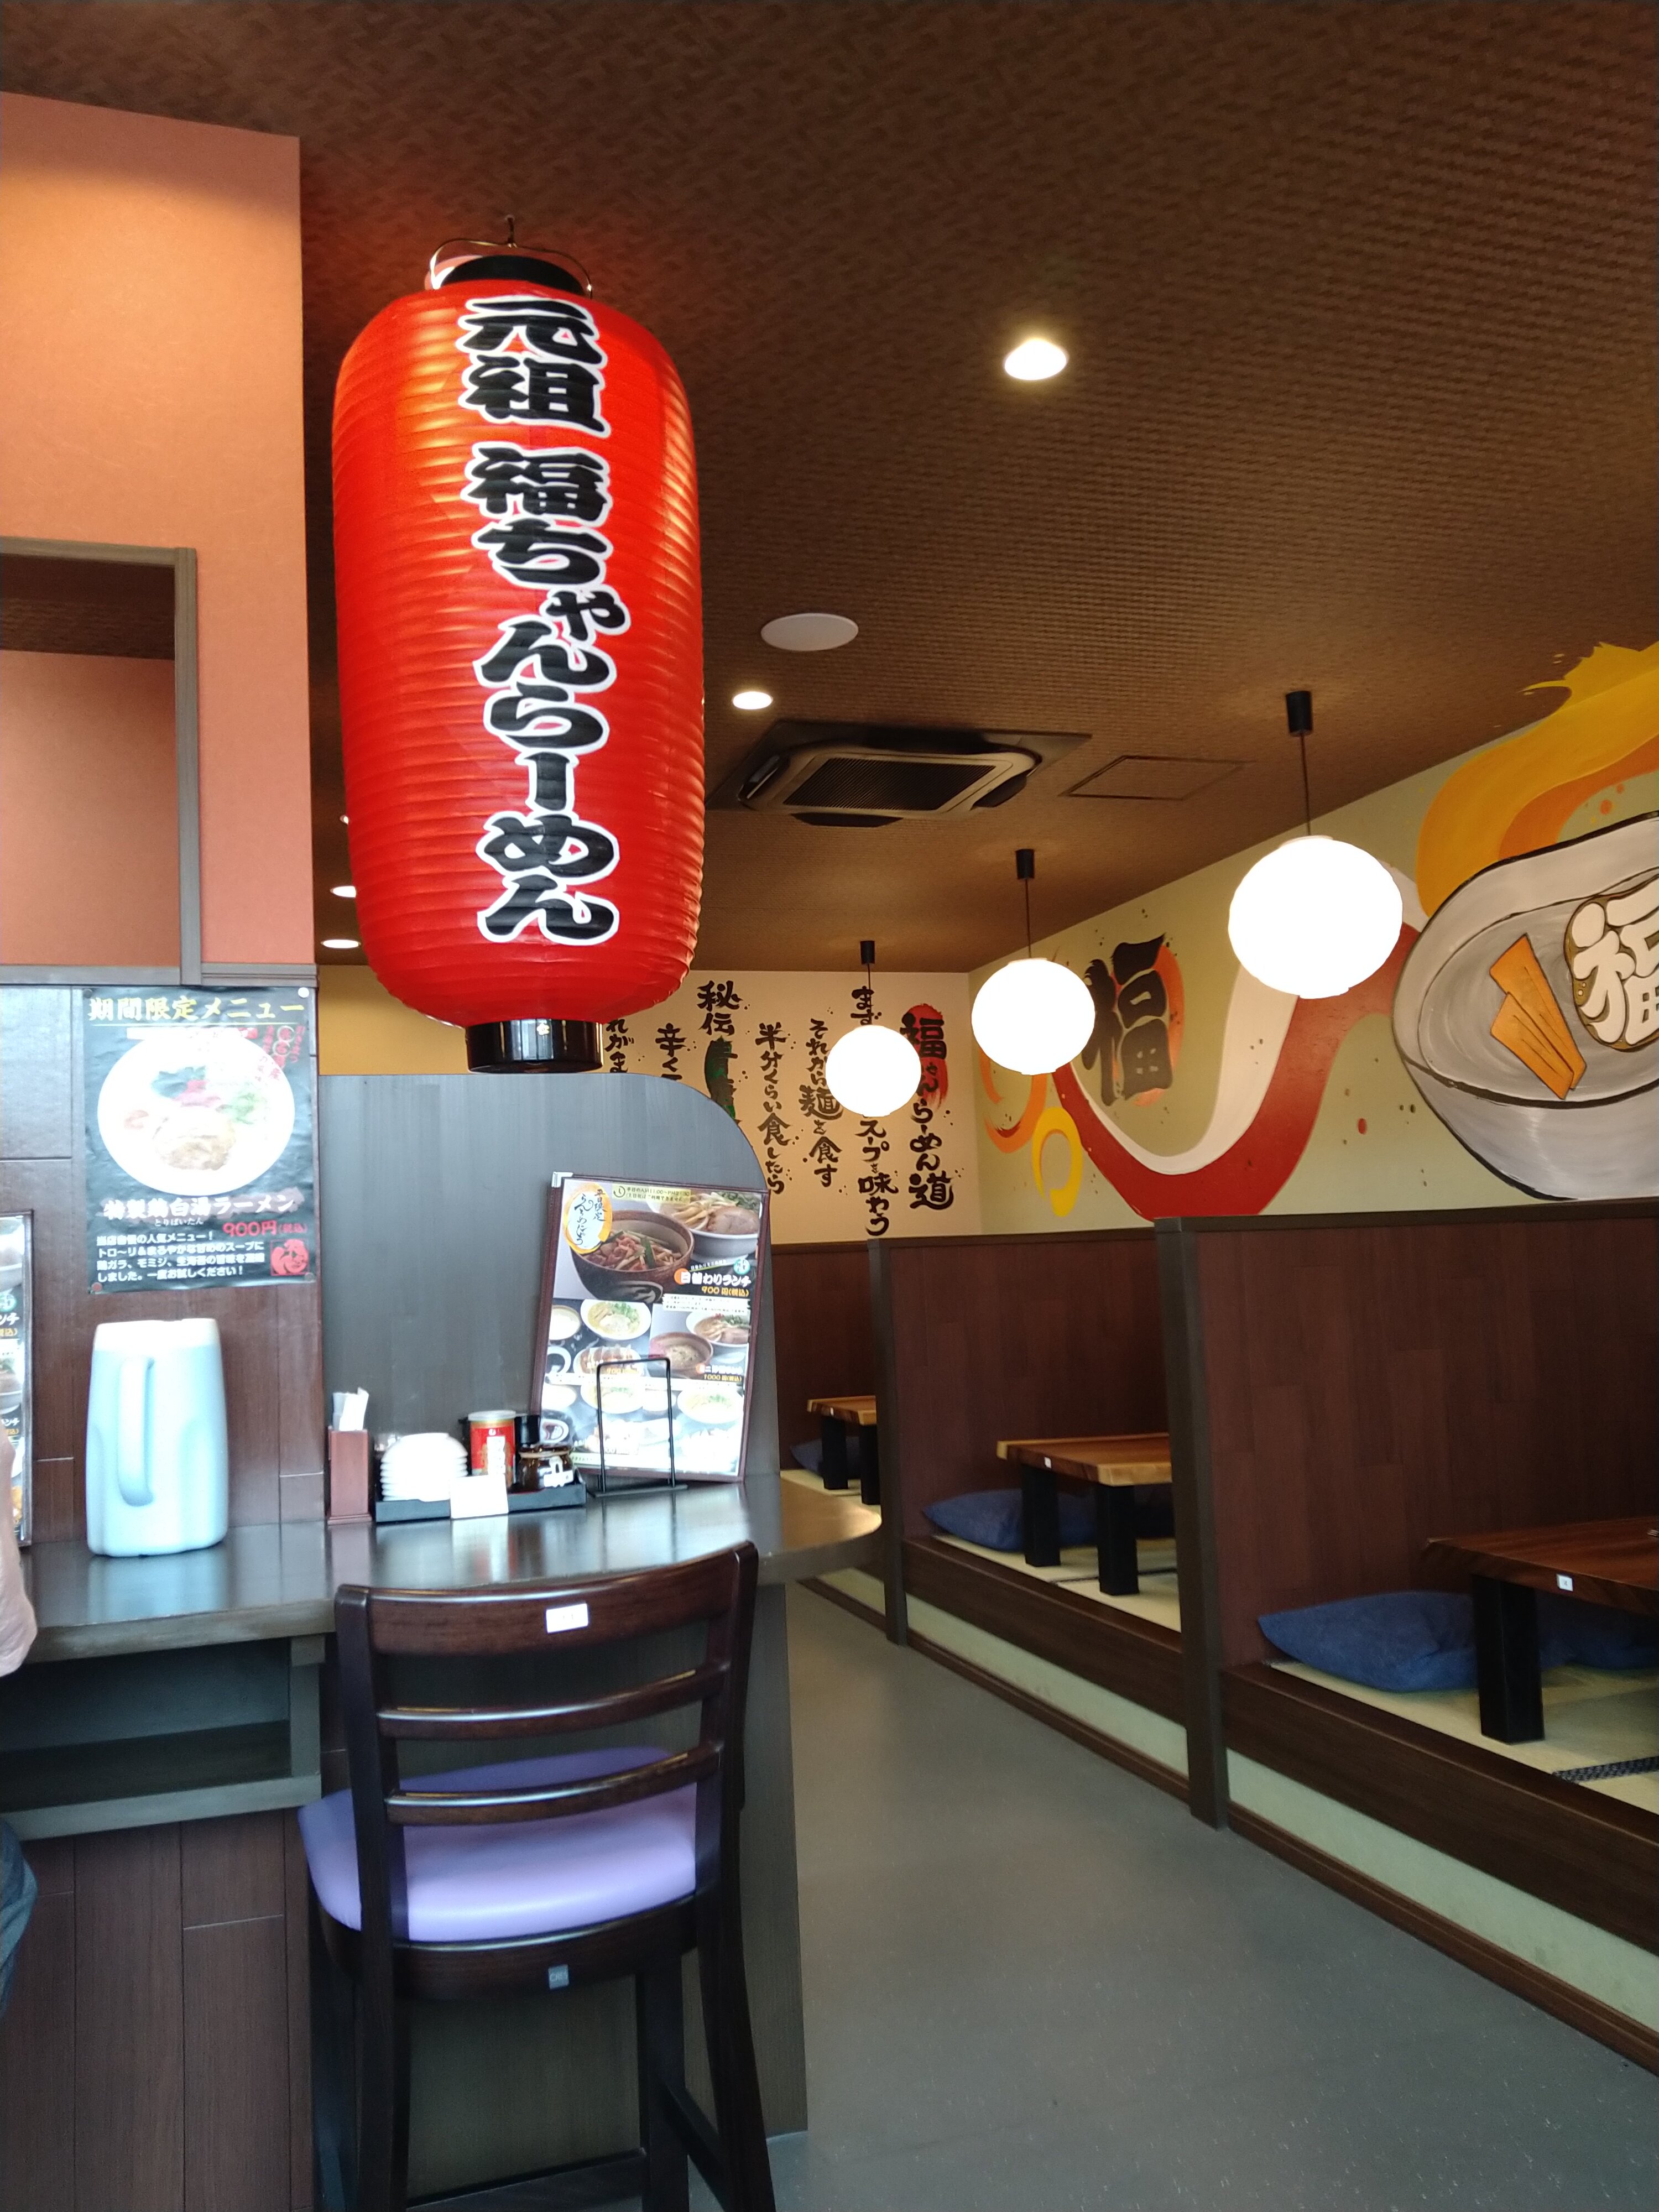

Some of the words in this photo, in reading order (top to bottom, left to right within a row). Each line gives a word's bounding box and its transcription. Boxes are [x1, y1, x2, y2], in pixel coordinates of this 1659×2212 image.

[456, 295, 610, 438] 元祖
[460, 441, 630, 946] 福ちゃんらーめん
[88, 995, 305, 1021] 期間限定メニュー
[655, 1022, 687, 1081] 辛く
[755, 1022, 791, 1194] 半分くらい食したら
[900, 1013, 953, 1211] 福ゃんらーめん道
[681, 1271, 752, 1288] 日替わりランチ
